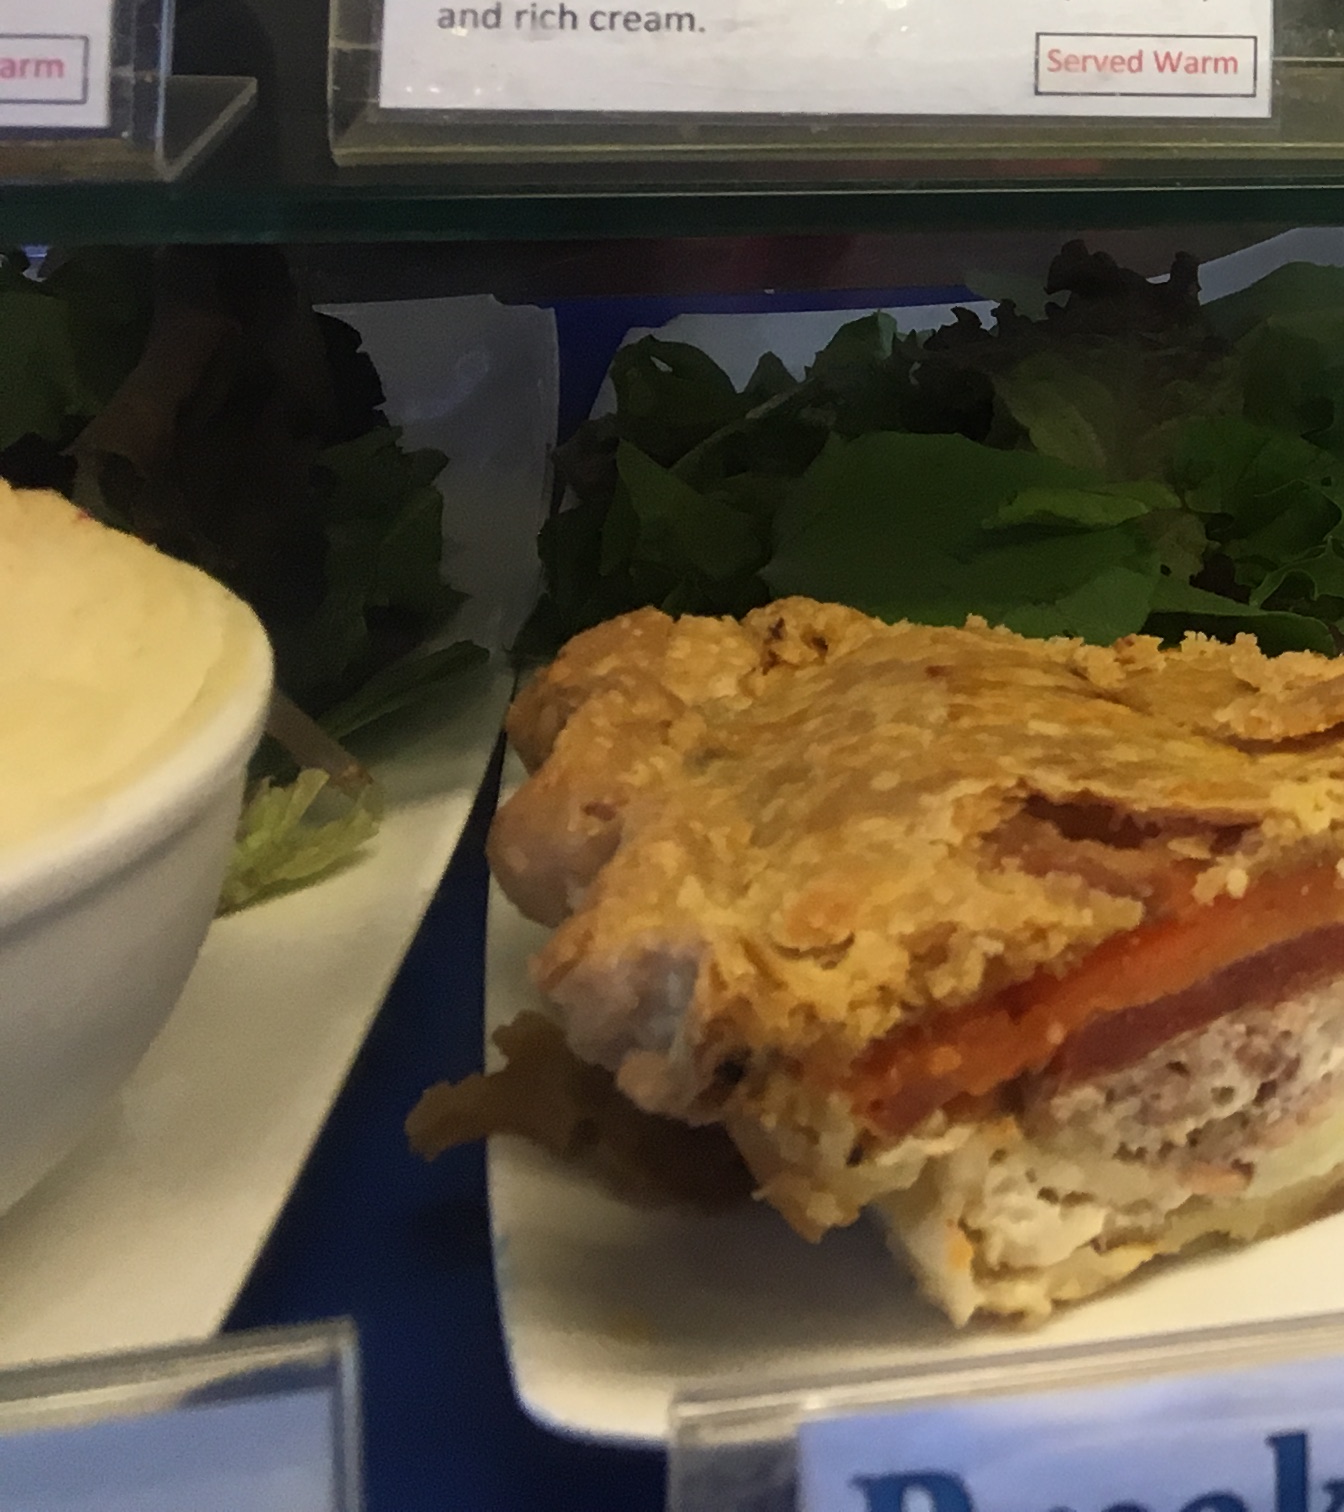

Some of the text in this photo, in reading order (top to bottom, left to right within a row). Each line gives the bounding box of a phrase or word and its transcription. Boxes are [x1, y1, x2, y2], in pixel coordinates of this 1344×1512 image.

[437, 1, 706, 33] and rich cream.
[0, 56, 65, 79] arm
[1046, 48, 1239, 75] Served Warm
